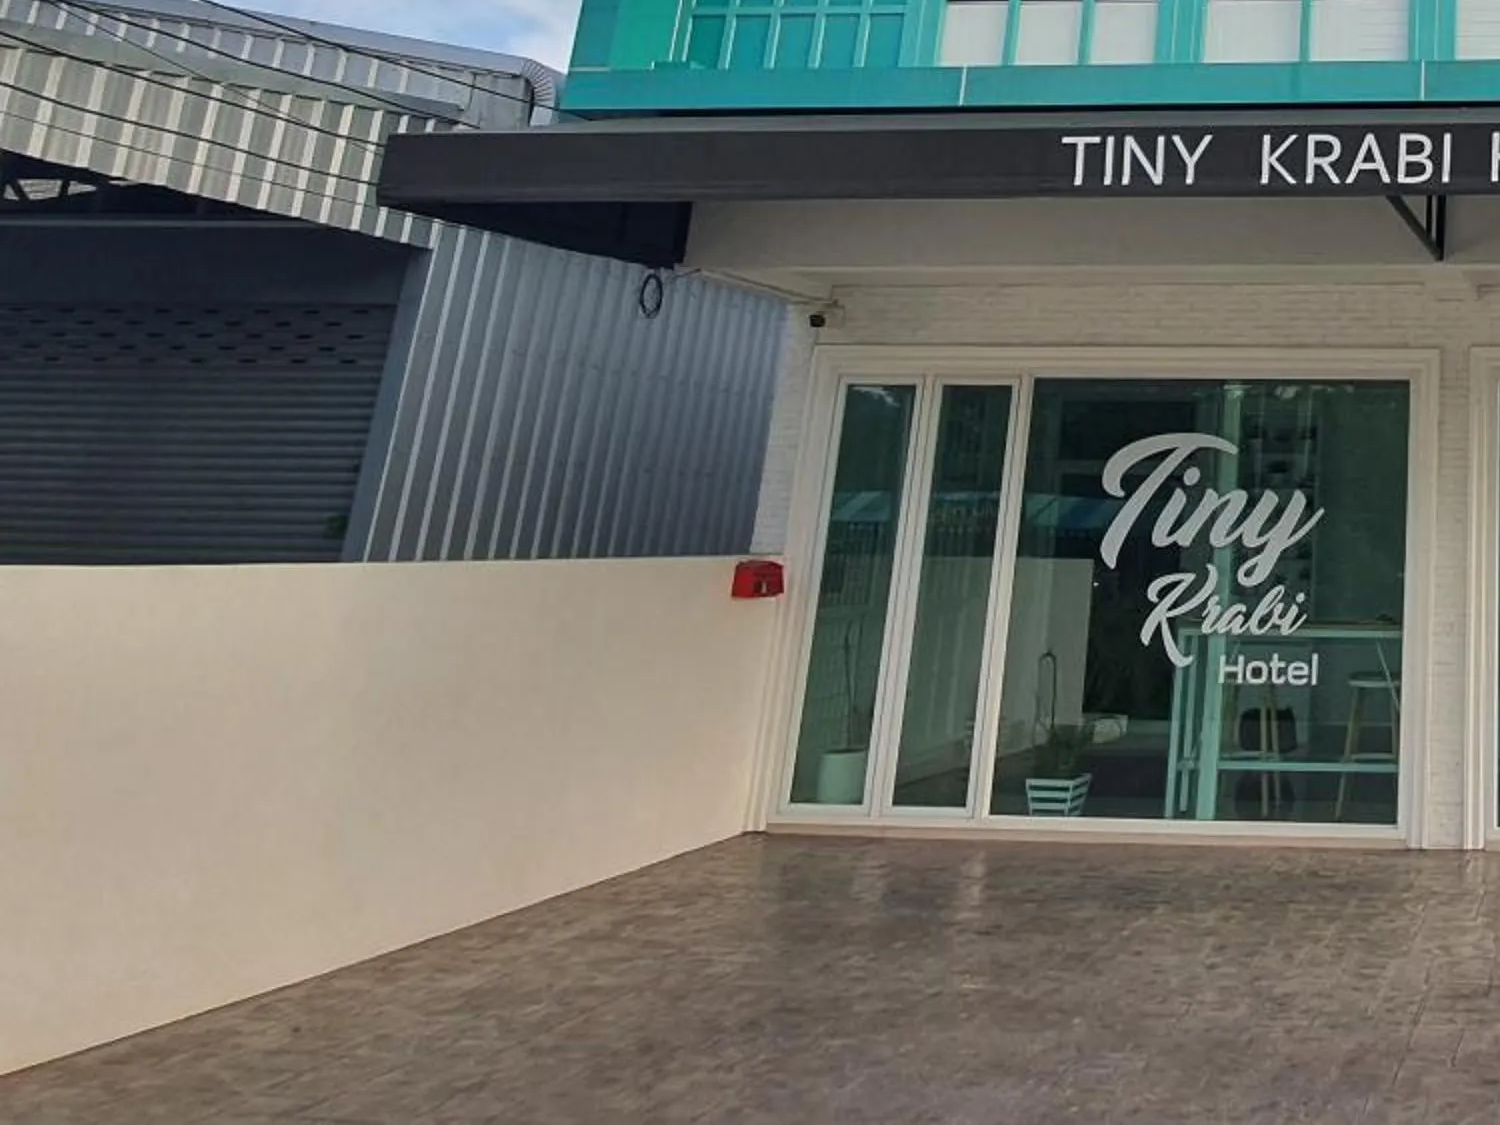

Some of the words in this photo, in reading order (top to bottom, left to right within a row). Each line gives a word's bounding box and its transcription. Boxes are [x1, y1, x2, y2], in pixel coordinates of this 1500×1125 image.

[1061, 134, 1213, 186] TINY
[1259, 132, 1451, 184] KRABI
[1100, 432, 1326, 588] Tiny
[1139, 563, 1308, 668] Krabi
[1217, 652, 1319, 686] Hotel
